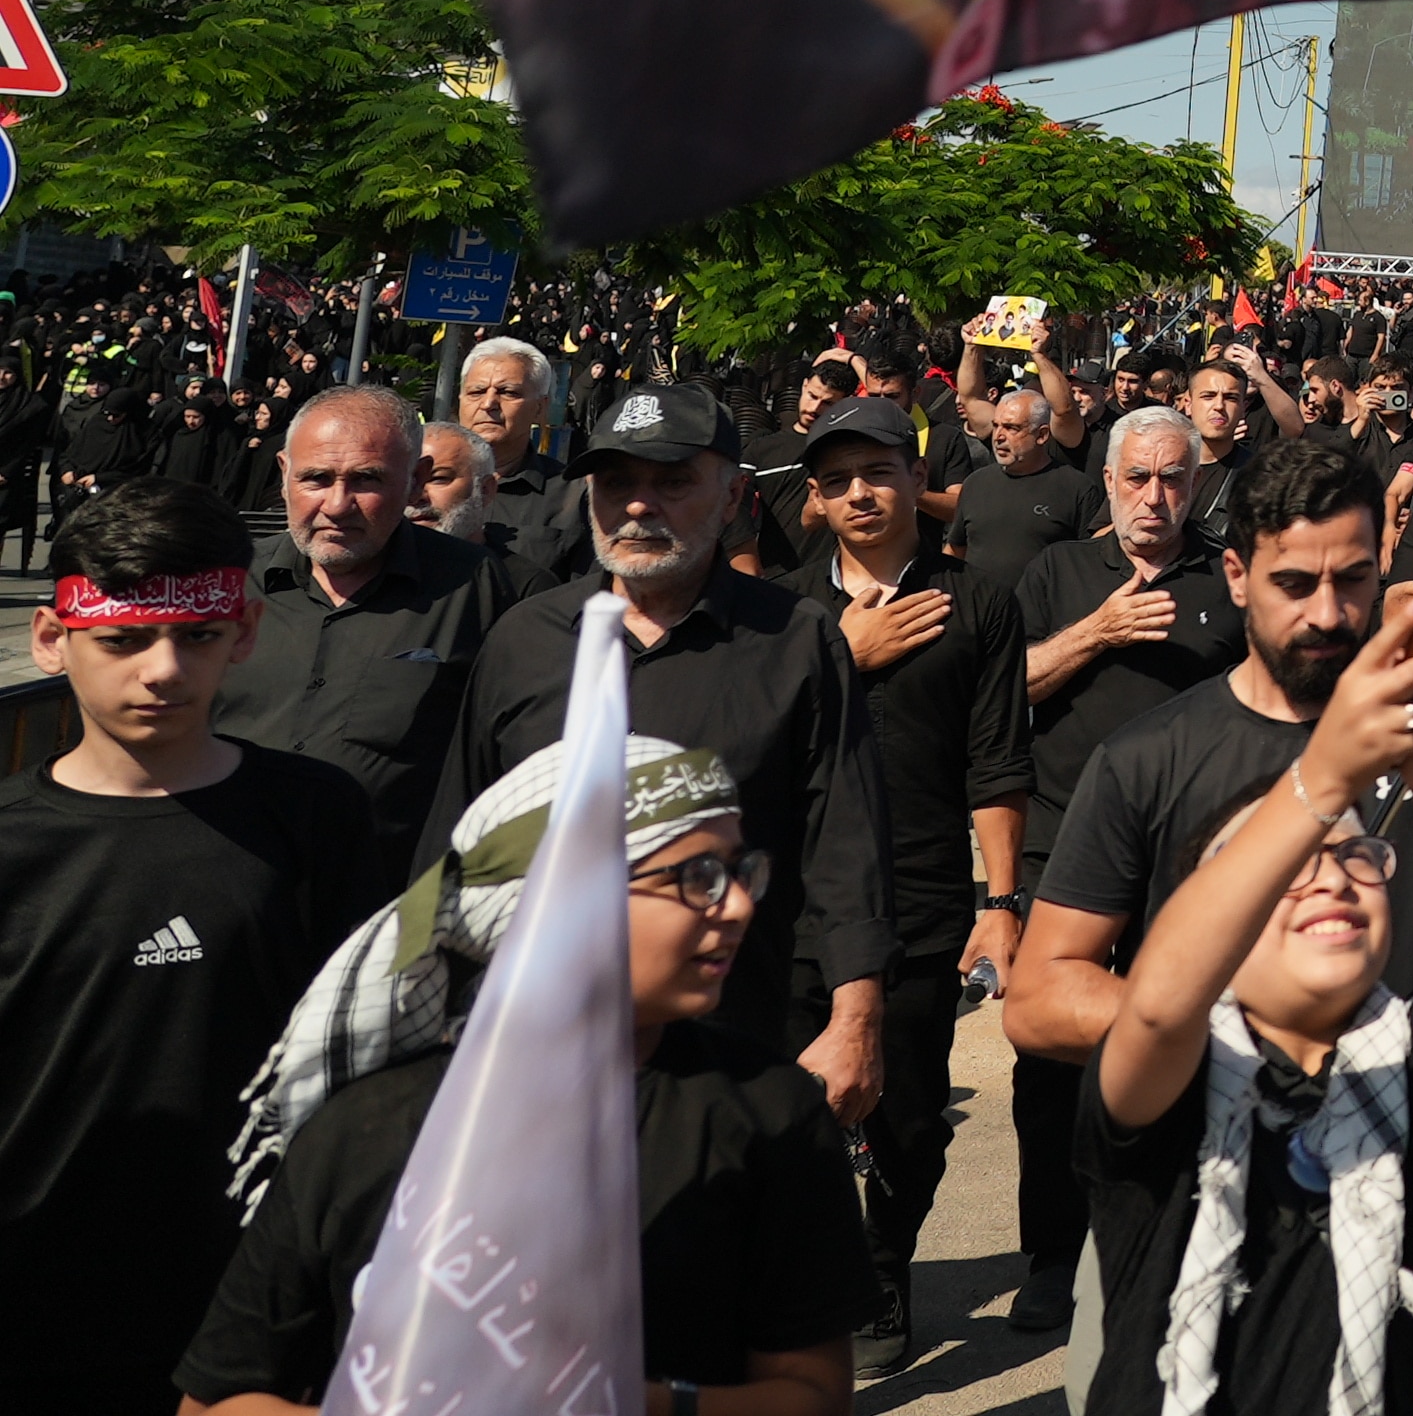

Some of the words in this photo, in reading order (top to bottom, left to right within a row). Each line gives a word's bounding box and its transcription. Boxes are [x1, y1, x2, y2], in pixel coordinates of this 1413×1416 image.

[456, 225, 487, 258] P
[422, 267, 471, 280] للسيارات
[474, 268, 502, 283] موقف
[440, 287, 459, 303] رقم
[463, 290, 490, 302] مدخل
[134, 946, 203, 967] adidas
